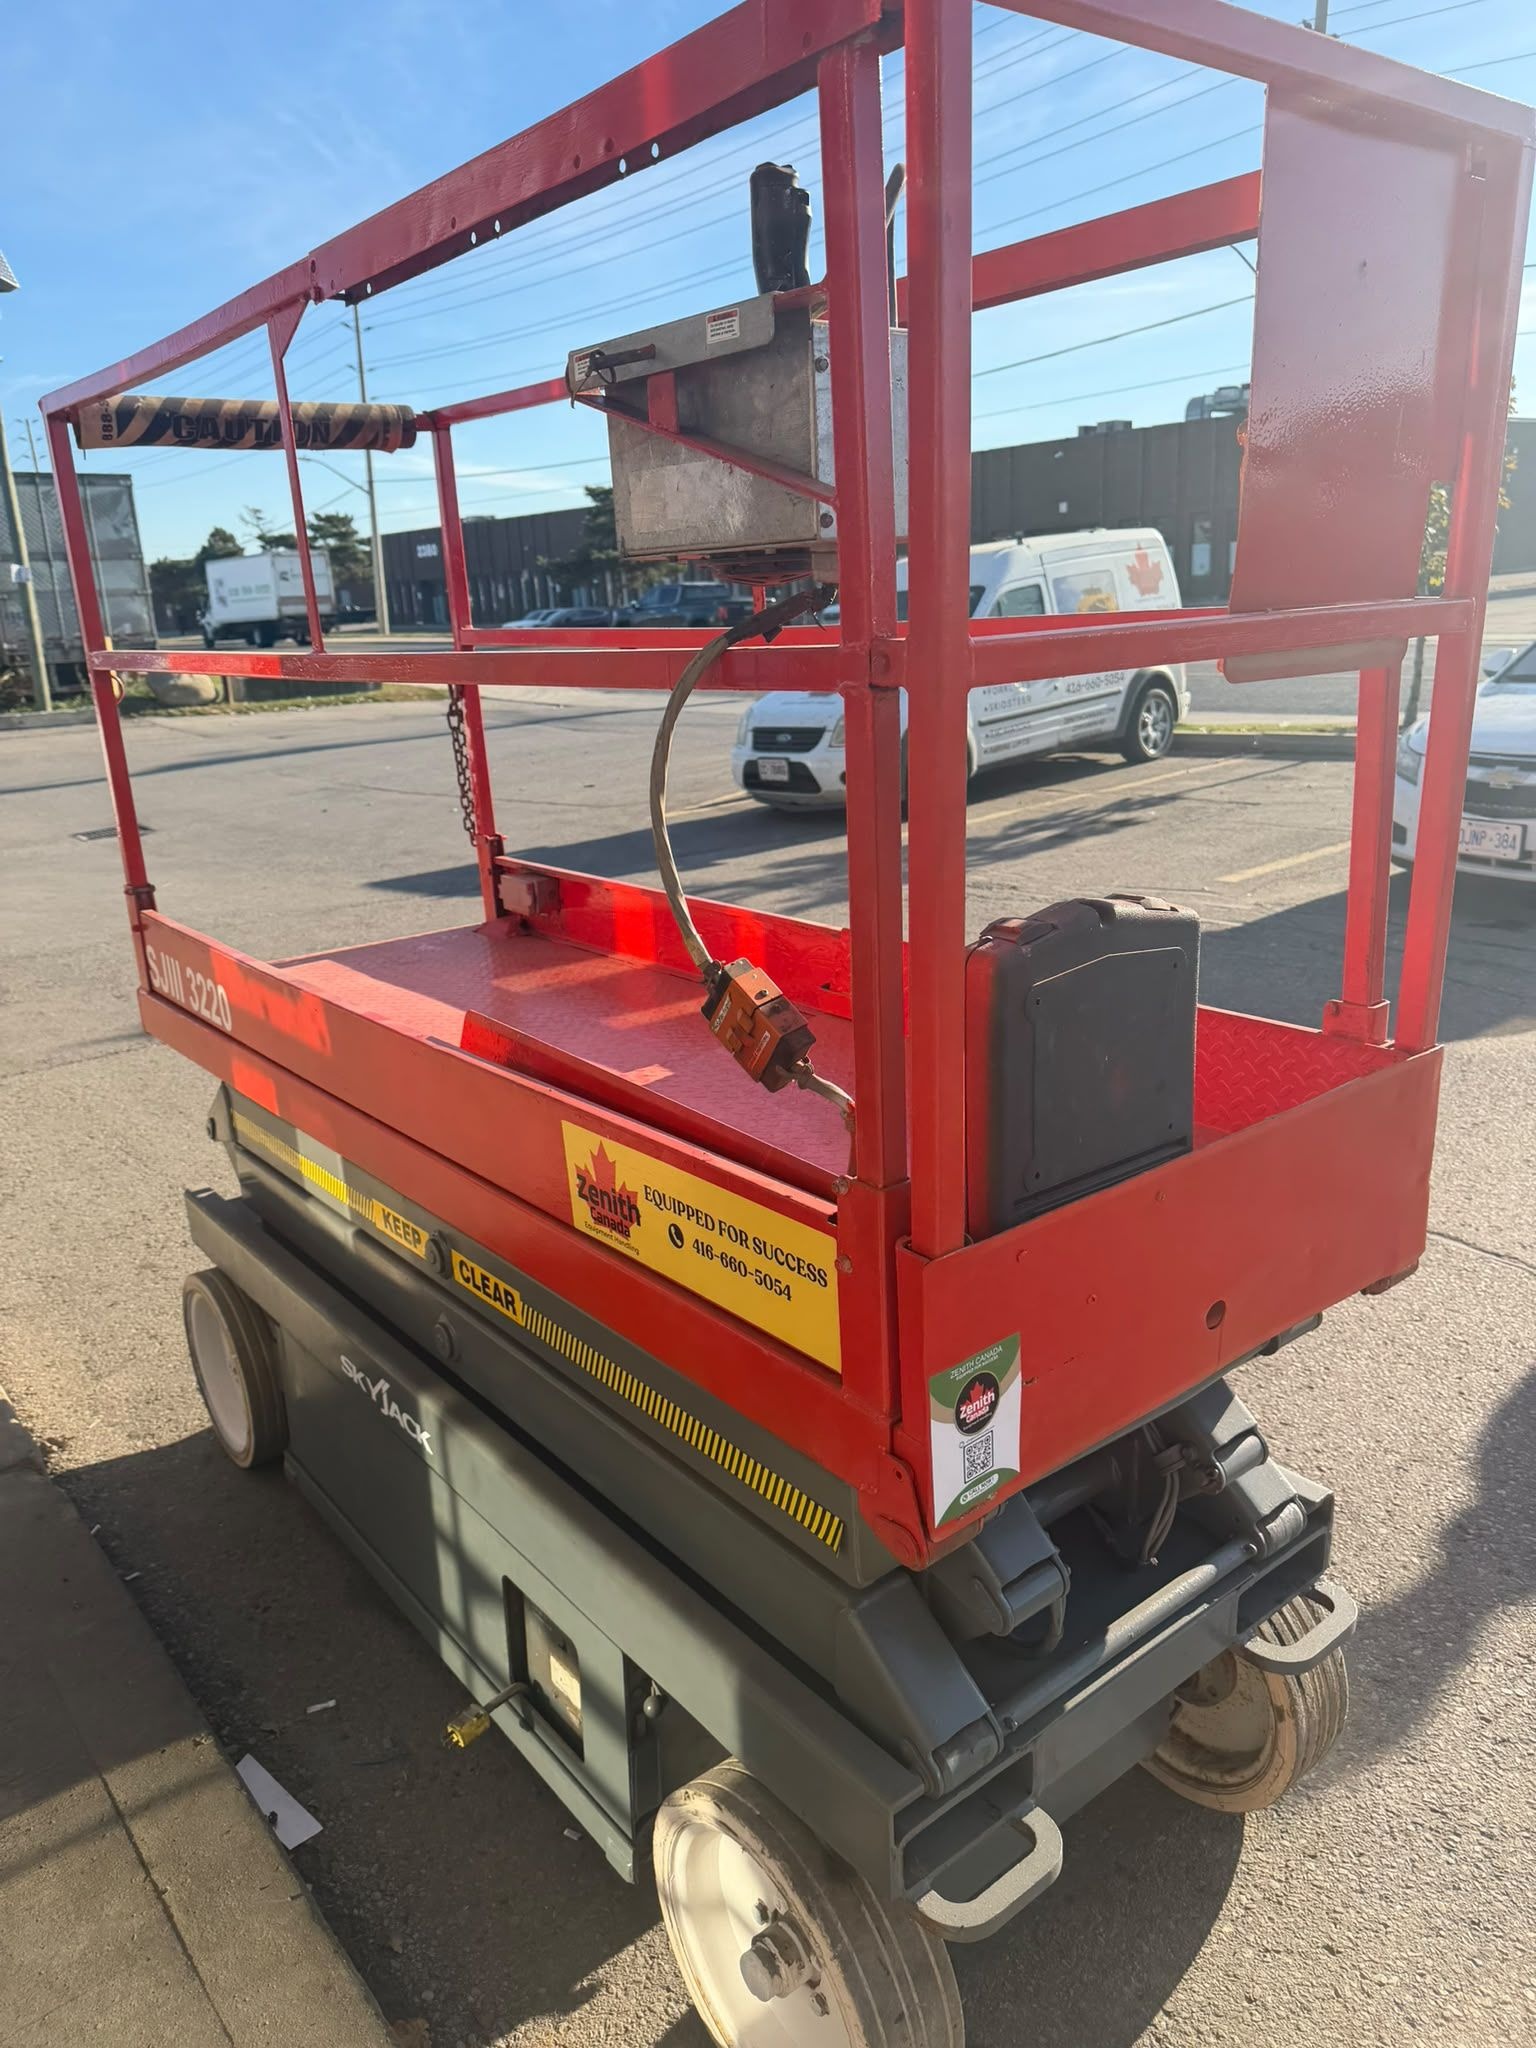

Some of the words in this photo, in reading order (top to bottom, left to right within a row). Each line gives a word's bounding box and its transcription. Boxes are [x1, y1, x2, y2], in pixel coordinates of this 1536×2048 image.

[171, 413, 332, 444] CAUTION
[1494, 832, 1517, 850] 384
[185, 966, 233, 1032] 3220
[576, 1173, 642, 1227] Zenith
[589, 1206, 632, 1239] Canada
[381, 1207, 423, 1250] KEEP
[457, 1258, 517, 1317] CLEAR
[643, 1184, 715, 1232] EQUIPPED
[718, 1218, 751, 1250] FOR
[752, 1236, 829, 1288] SUCCESS
[692, 1238, 793, 1302] 416-660-5054
[950, 1359, 975, 1380] ZENITH
[975, 1344, 1003, 1365] CANADA
[339, 1354, 434, 1456] SKYJACK
[959, 1390, 996, 1420] Zenith
